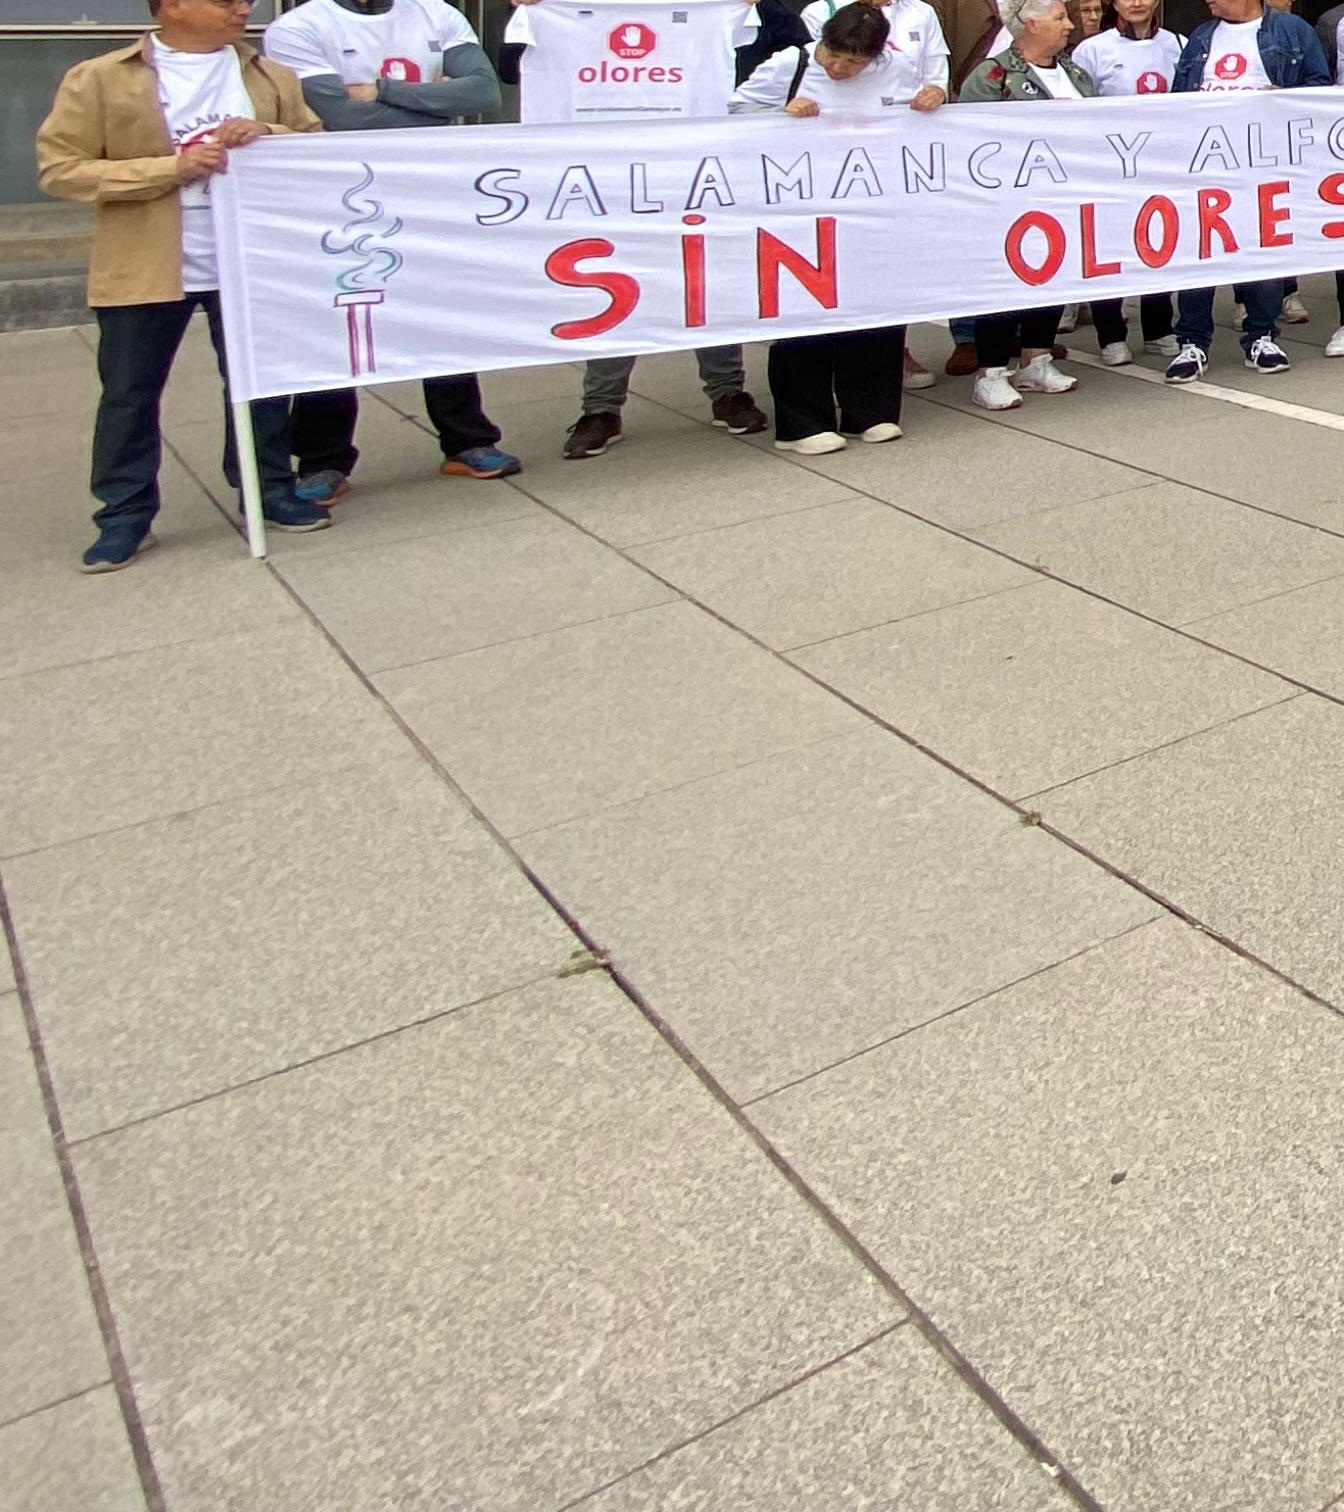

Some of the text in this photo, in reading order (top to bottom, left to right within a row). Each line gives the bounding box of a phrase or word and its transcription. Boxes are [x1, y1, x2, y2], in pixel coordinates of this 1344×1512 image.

[619, 48, 646, 57] STOP
[578, 60, 683, 83] olores
[474, 138, 1068, 226] SALAMANCA
[1106, 131, 1152, 178] Y
